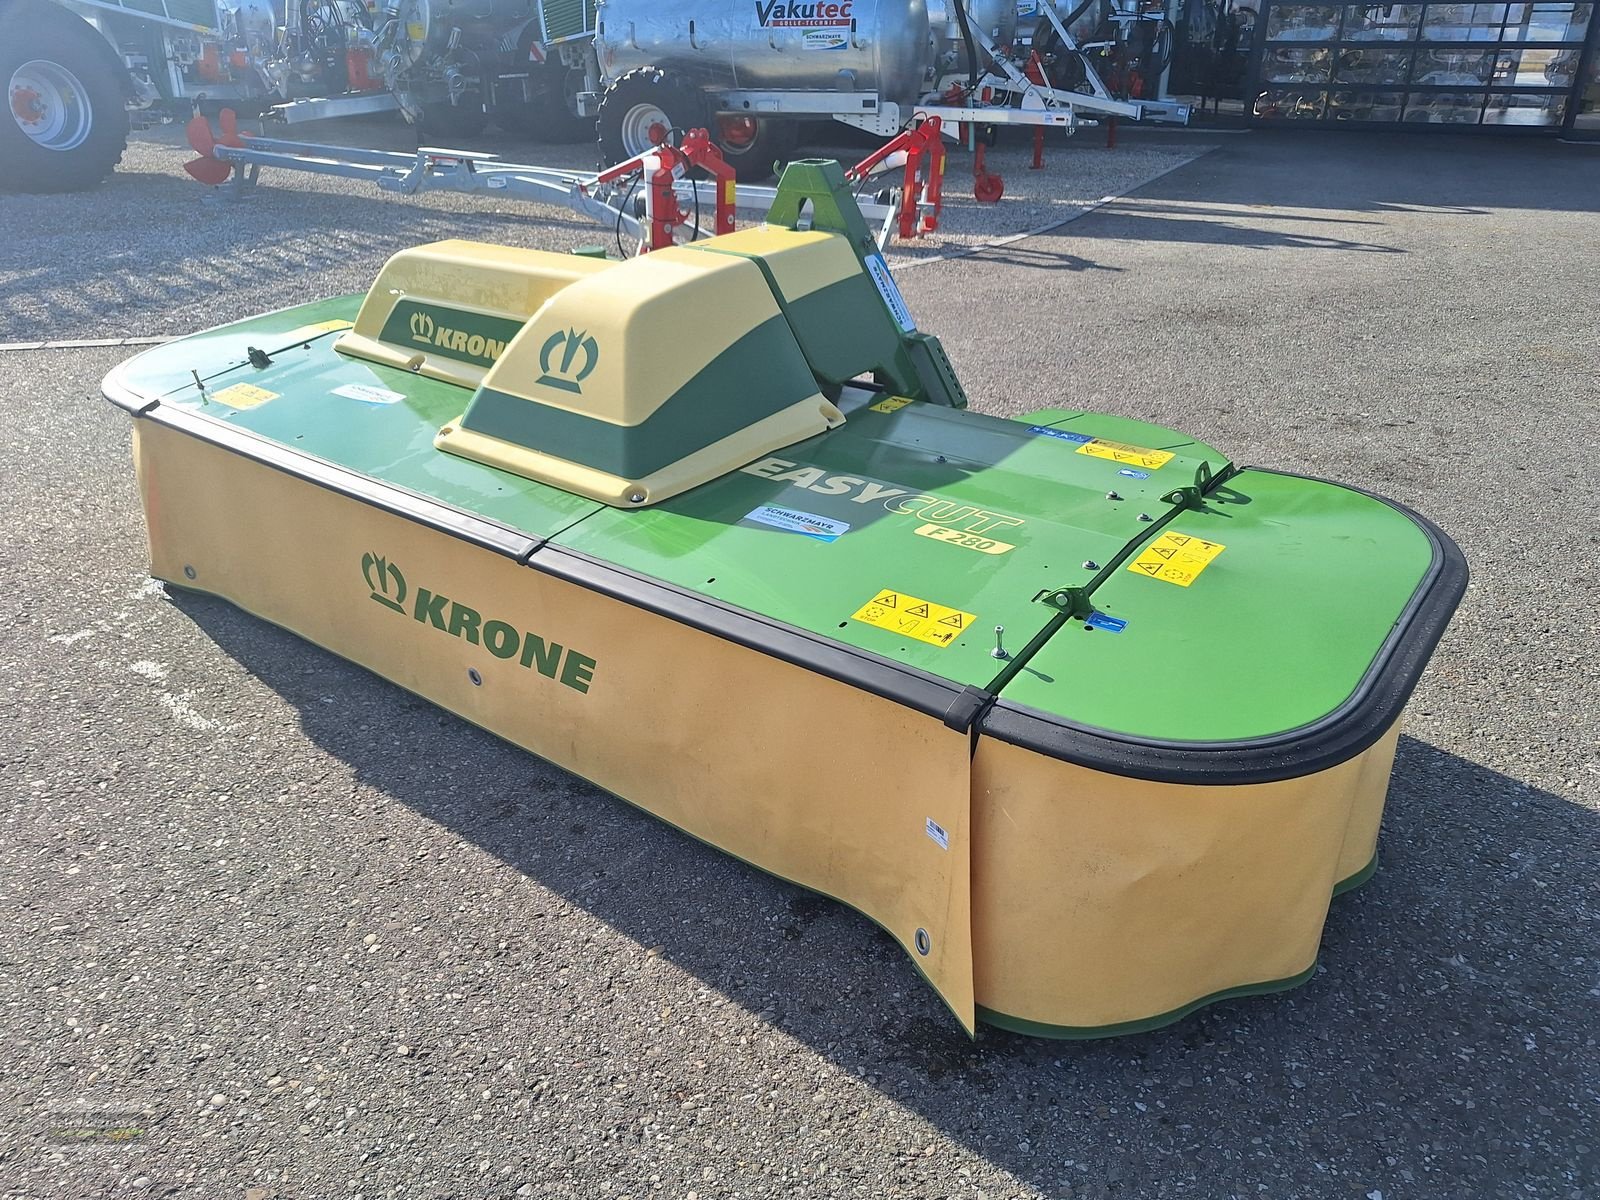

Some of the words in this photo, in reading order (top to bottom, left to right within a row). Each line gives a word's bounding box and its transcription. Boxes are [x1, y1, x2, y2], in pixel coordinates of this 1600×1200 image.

[755, 0, 853, 27] Vakutec
[434, 326, 510, 361] KRON
[764, 507, 835, 530] SCHWARZMAYR
[927, 528, 950, 536] F
[945, 533, 996, 550] 280
[413, 587, 597, 695] KRONE
